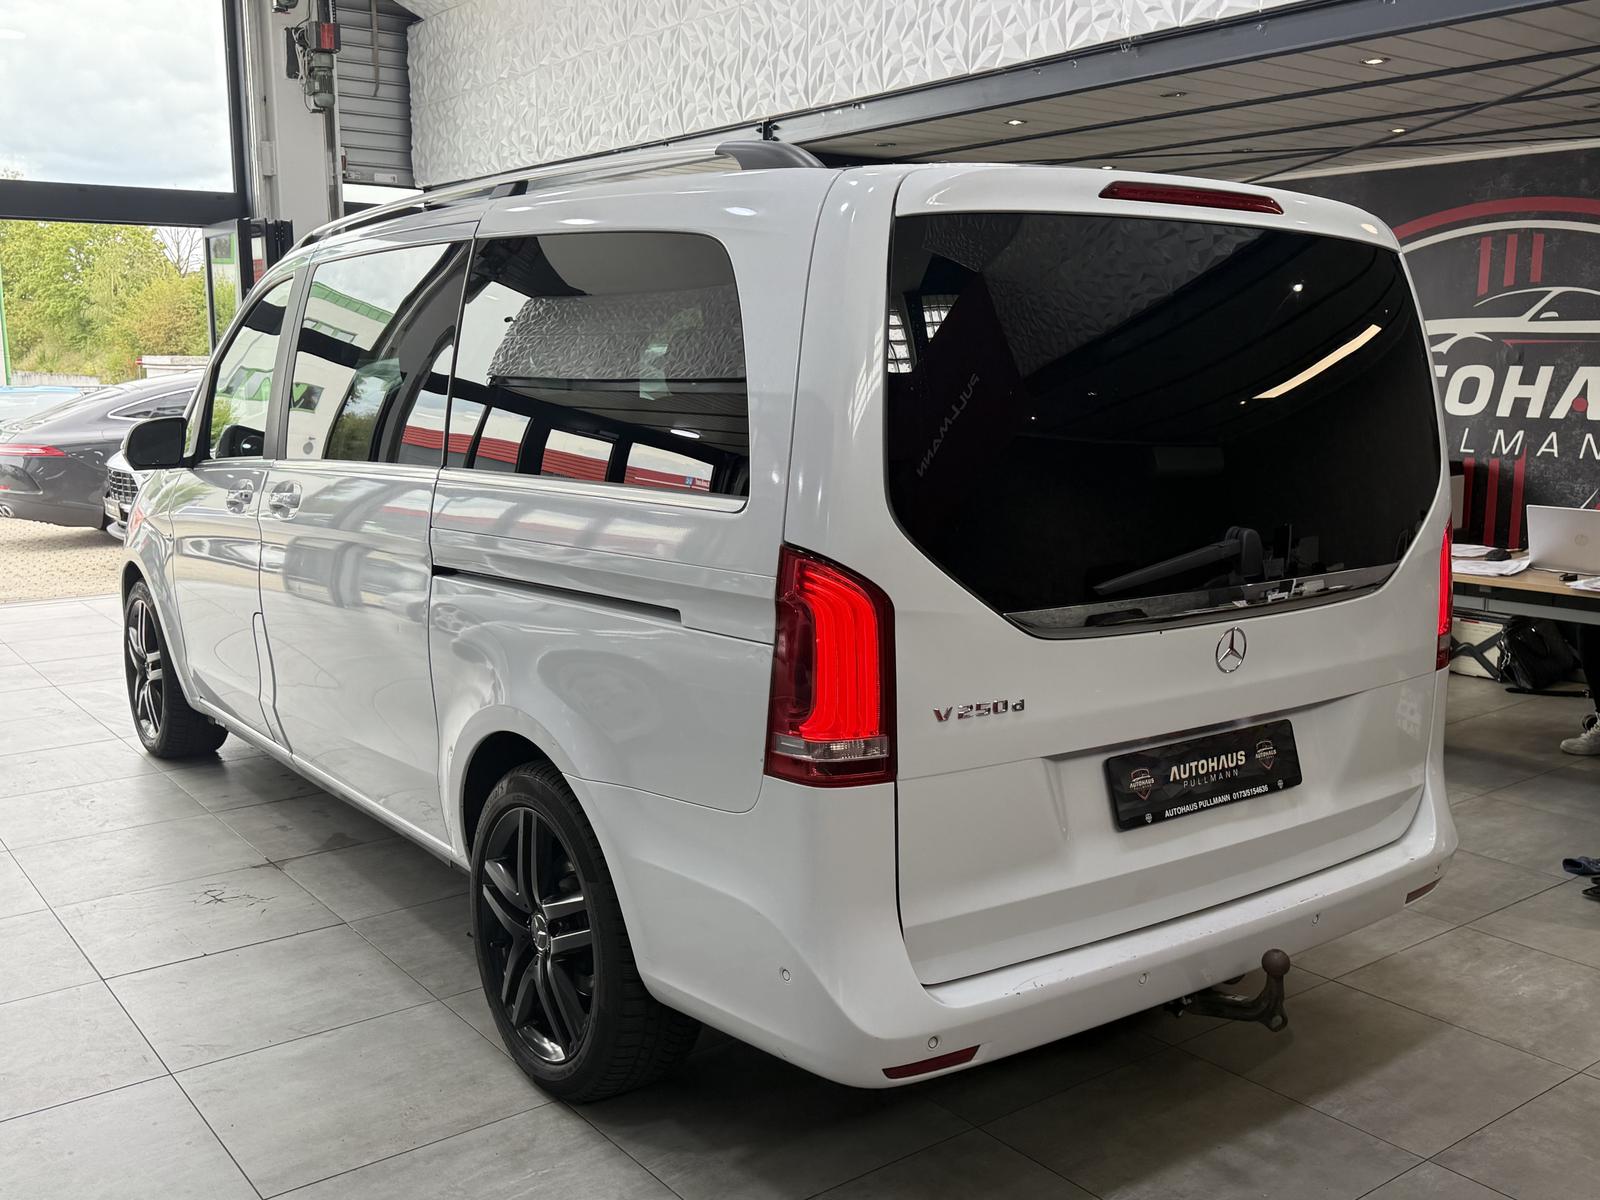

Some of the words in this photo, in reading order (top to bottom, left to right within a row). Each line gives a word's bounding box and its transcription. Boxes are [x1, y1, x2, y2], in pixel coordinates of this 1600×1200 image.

[1169, 750, 1246, 782] AUTOHAUS
[1183, 768, 1239, 788] PULLMANN
[1164, 802, 1198, 818] AUTOHAUS
[1198, 794, 1231, 809] PULLMANN
[1232, 784, 1269, 800] 0173/5154636
